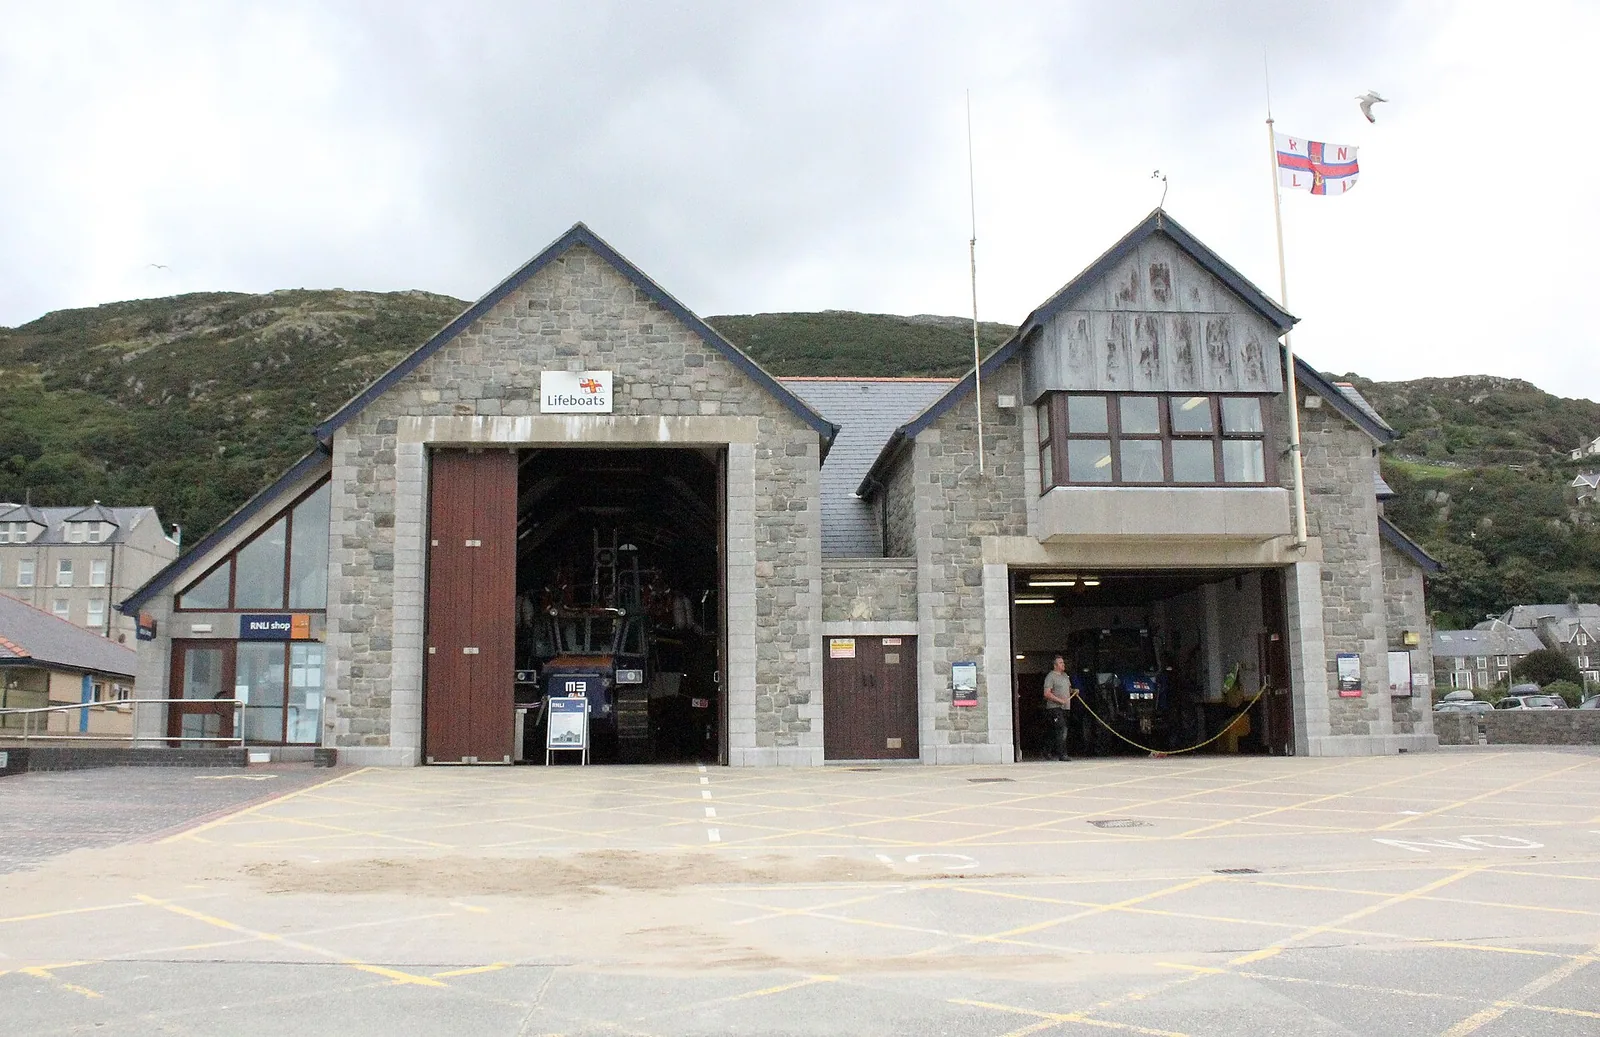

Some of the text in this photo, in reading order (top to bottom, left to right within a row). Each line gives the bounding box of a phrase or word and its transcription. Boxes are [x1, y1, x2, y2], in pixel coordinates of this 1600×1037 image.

[1288, 138, 1347, 161] R N
[1292, 174, 1301, 187] L
[547, 394, 605, 406] Lifeboats
[249, 621, 291, 631] RNLI shop
